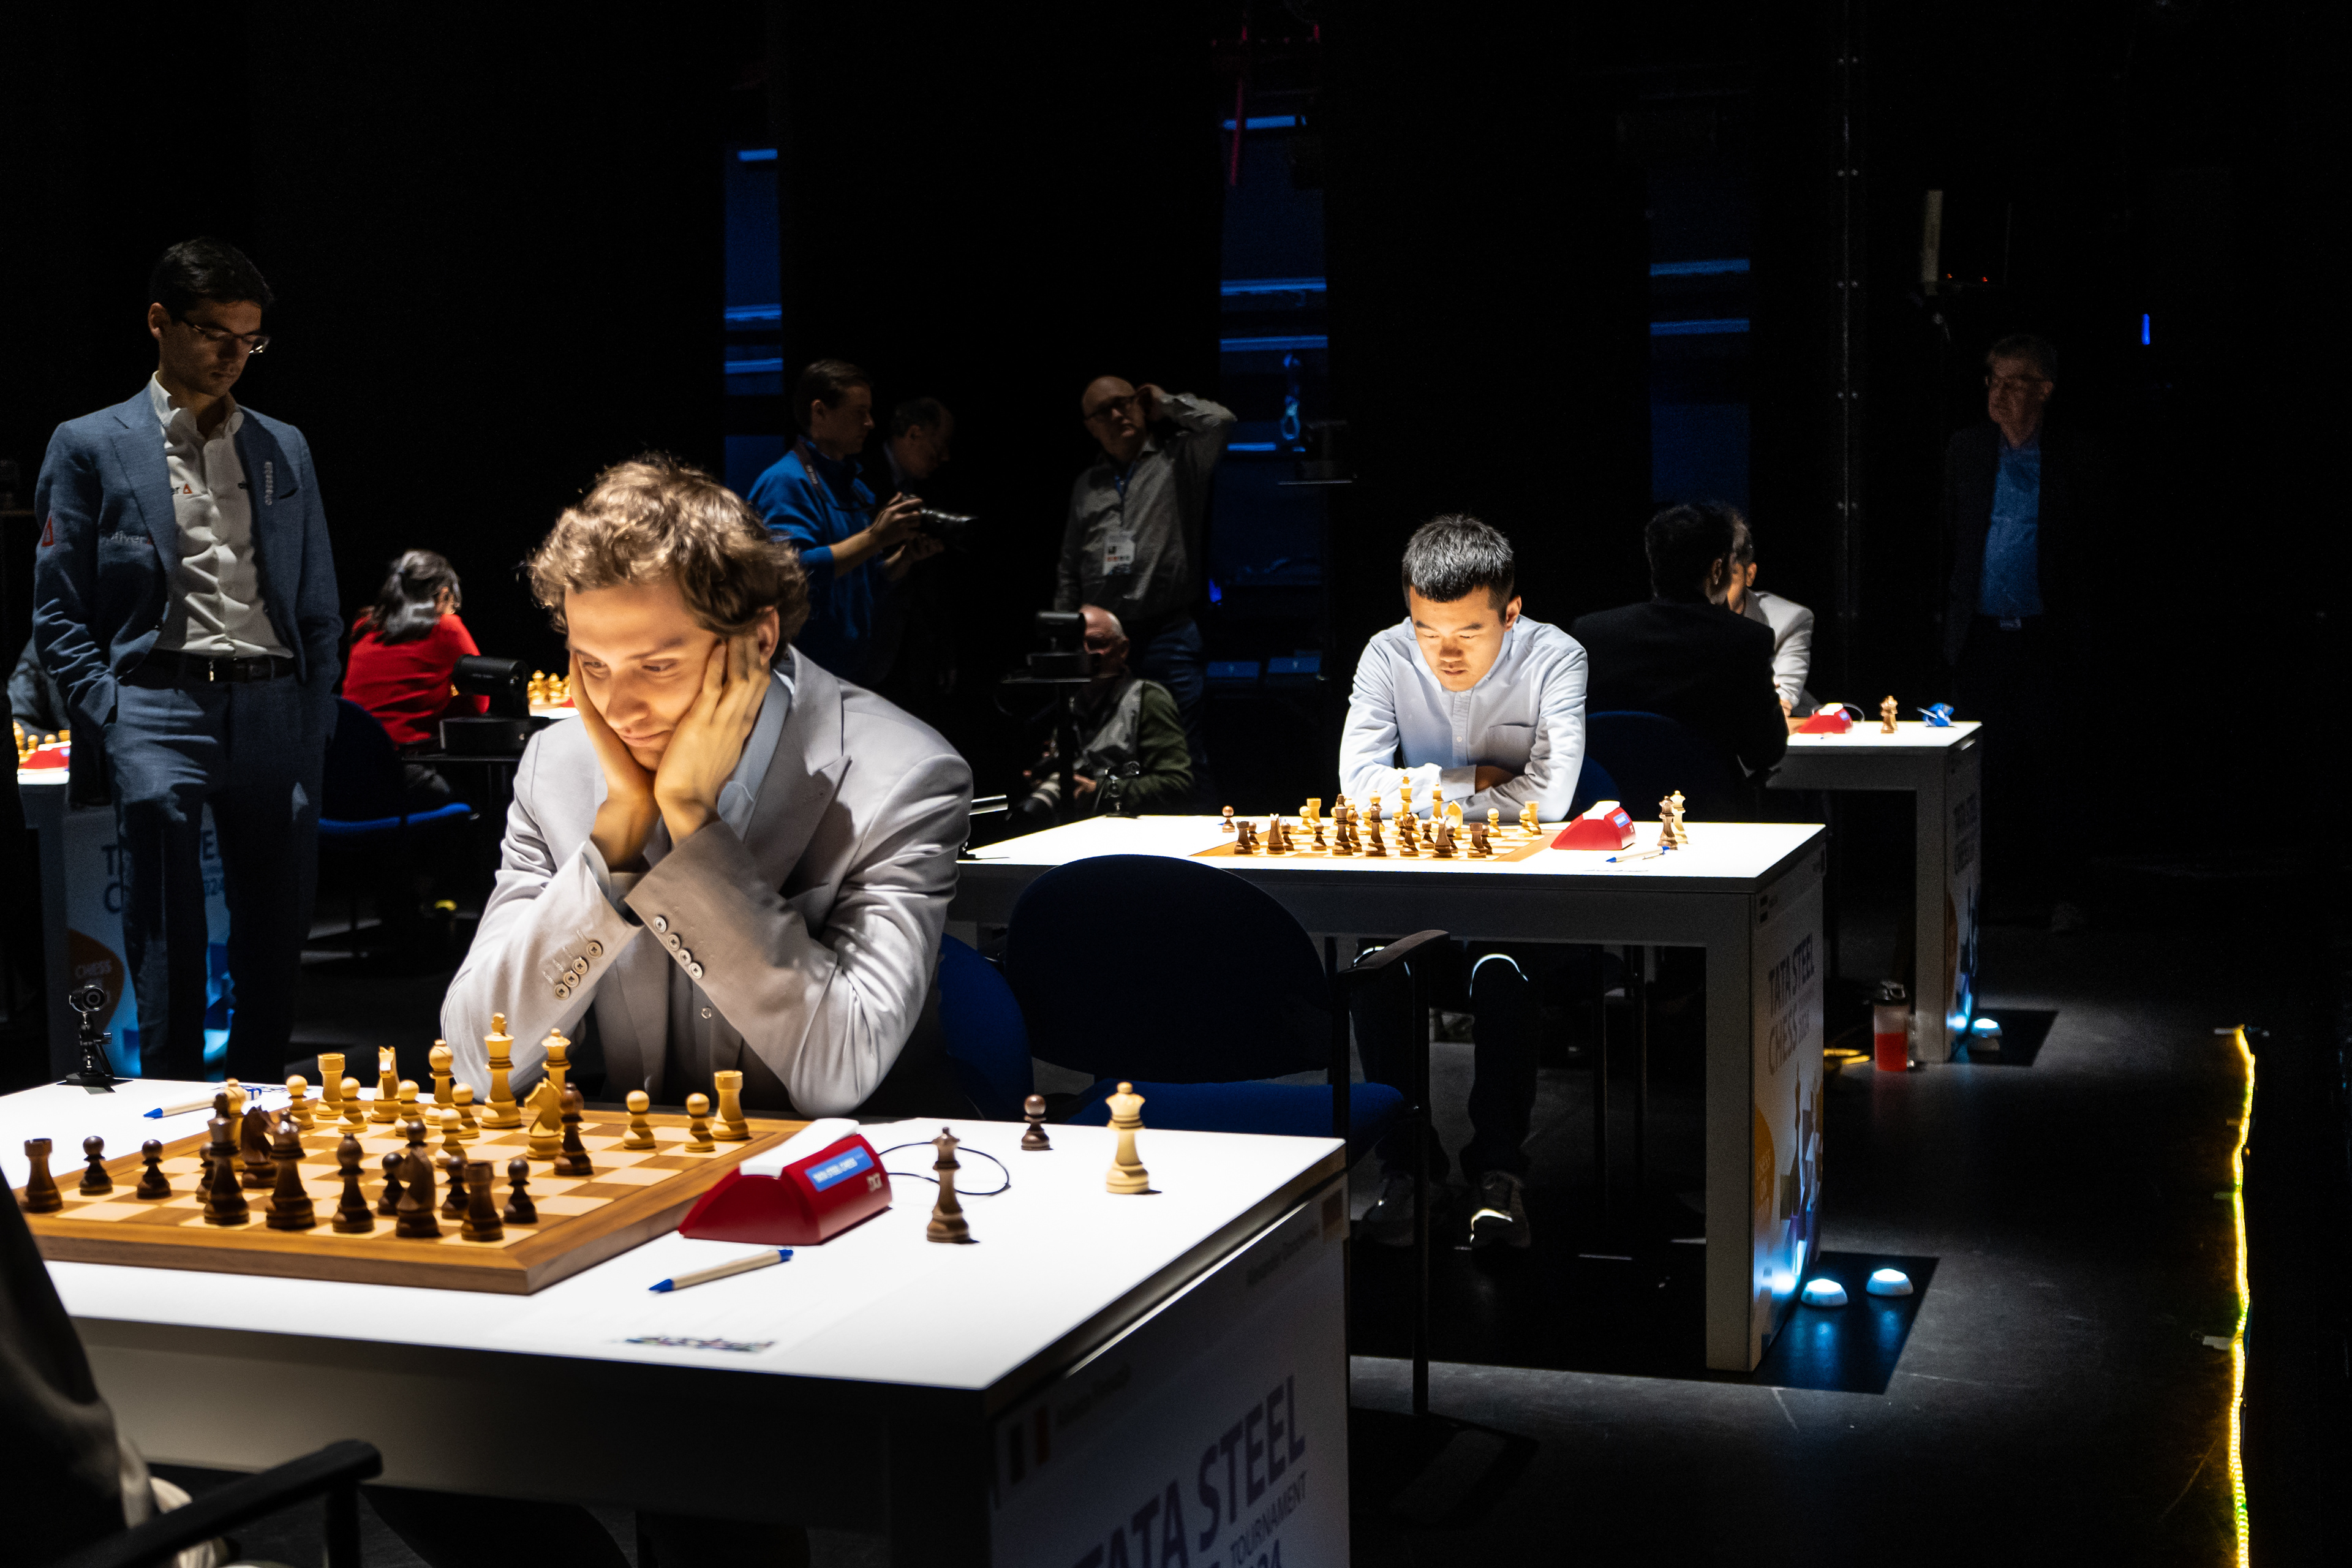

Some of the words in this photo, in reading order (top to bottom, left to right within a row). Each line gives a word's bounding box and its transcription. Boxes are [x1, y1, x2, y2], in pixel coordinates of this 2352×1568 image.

[1768, 955, 1792, 1017] TATA
[1793, 933, 1814, 995] STEEL
[1768, 1002, 1797, 1076] CHESS
[1073, 1479, 1188, 1568] TA
[1197, 1374, 1306, 1552] STEEL
[1229, 1471, 1307, 1566] TOURNAMENT
